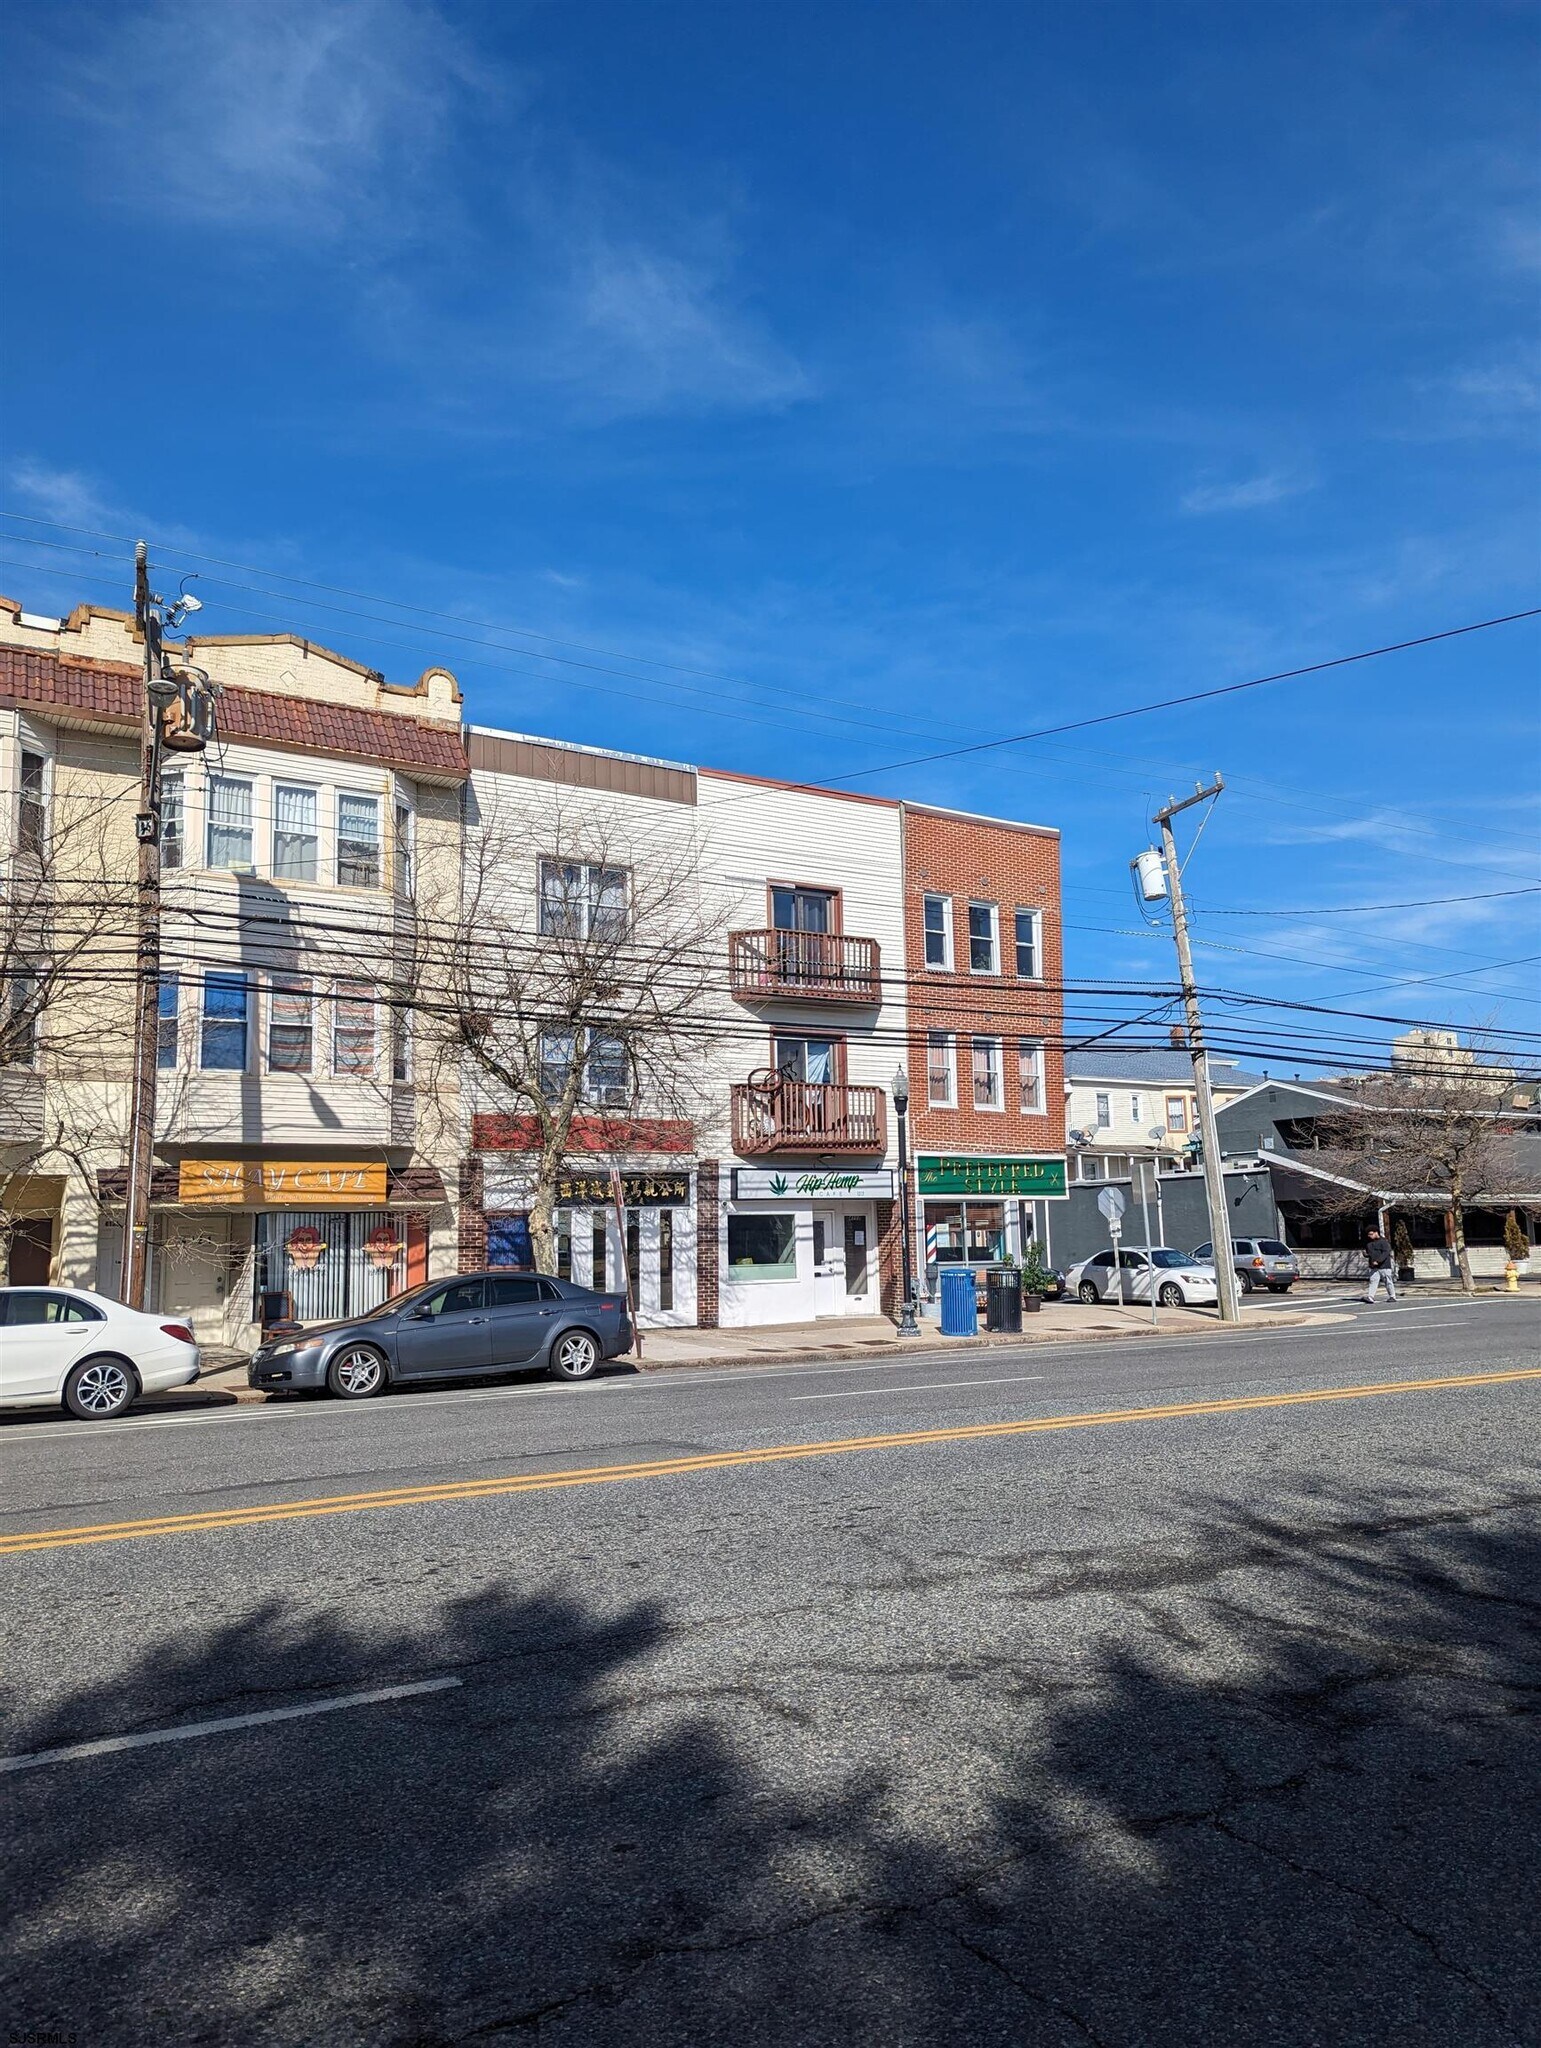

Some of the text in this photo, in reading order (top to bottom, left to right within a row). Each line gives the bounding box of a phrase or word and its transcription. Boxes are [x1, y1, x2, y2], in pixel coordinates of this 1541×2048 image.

[940, 1157, 1045, 1178] PREFERRED
[200, 1167, 370, 1192] SHAY CAFE
[964, 1179, 1022, 1194] STYLE
